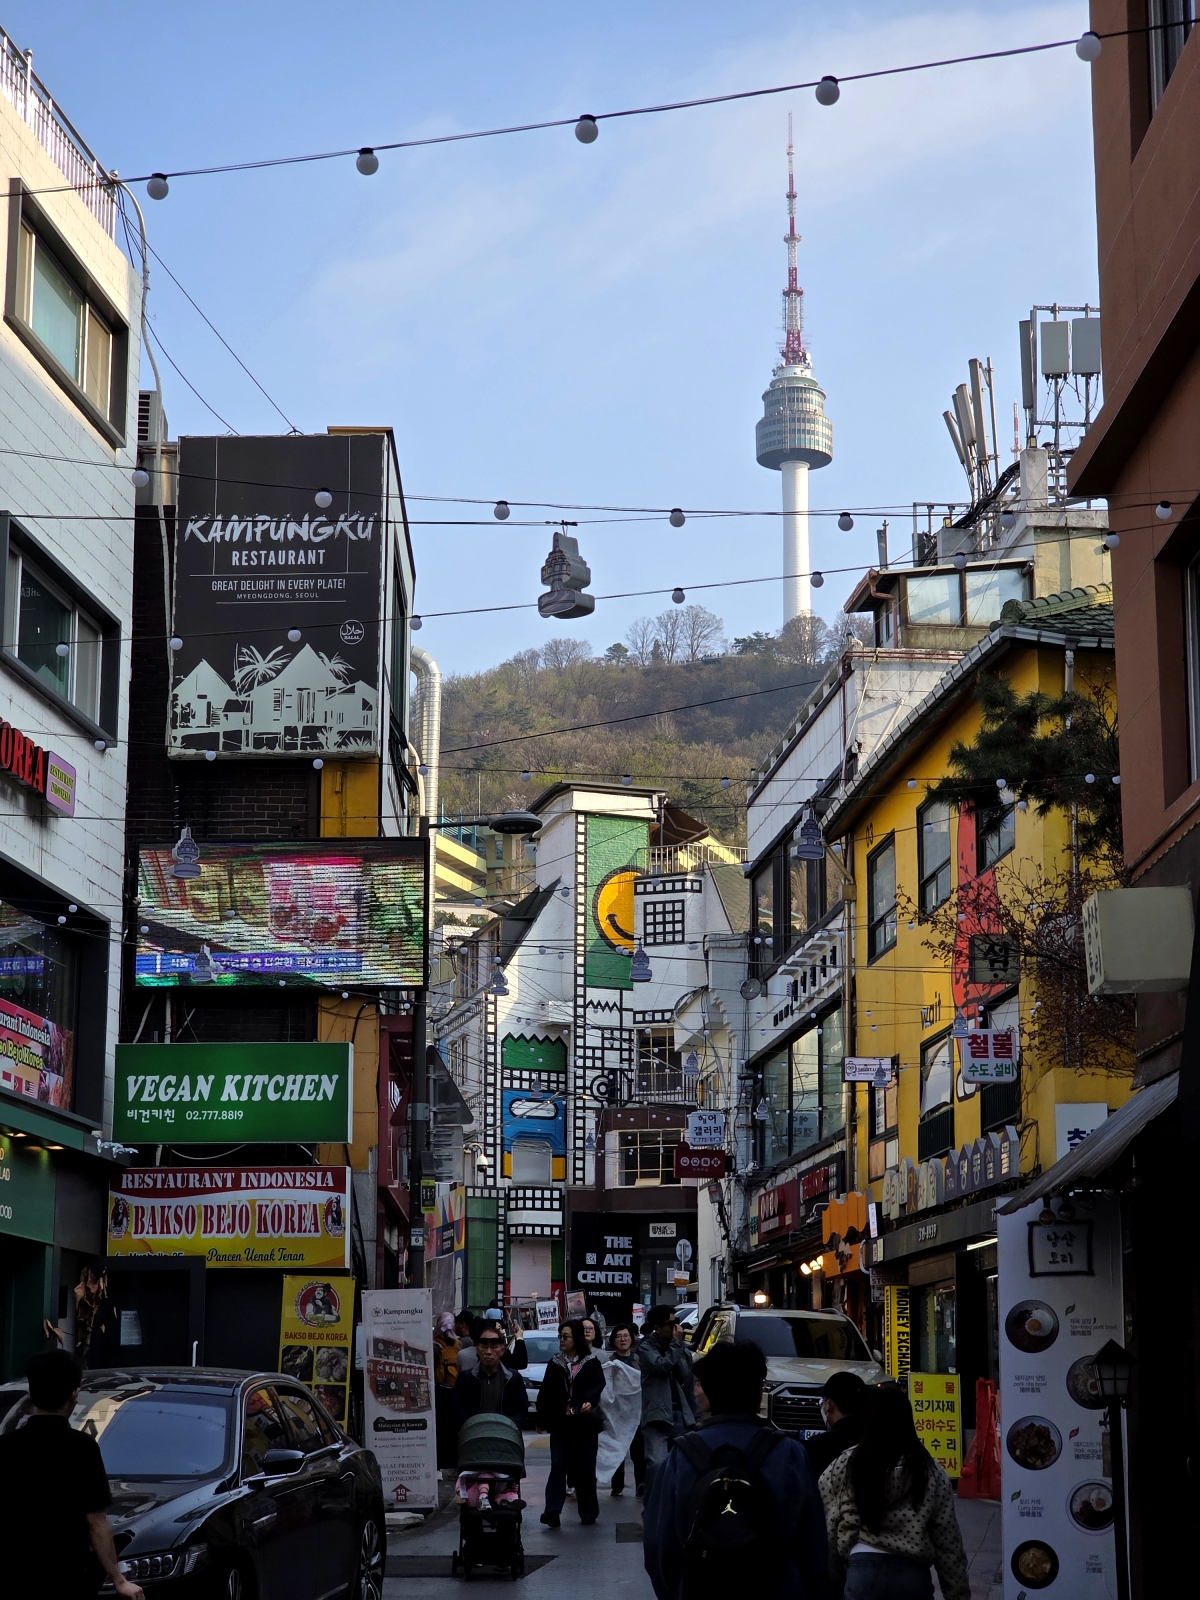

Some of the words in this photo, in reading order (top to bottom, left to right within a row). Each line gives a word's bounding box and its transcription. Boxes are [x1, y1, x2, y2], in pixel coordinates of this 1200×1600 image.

[184, 512, 378, 543] KAMPUNGKU
[231, 550, 326, 566] RESTAURANT
[211, 580, 238, 591] GREAT
[240, 580, 275, 591] DELIGHT
[277, 580, 286, 590] IN
[288, 579, 315, 590] EVERY
[317, 578, 346, 589] PLATE!
[0, 717, 44, 793] OREA
[18, 1016, 50, 1046] Indonesia
[968, 1033, 1012, 1058] 철물
[7, 1040, 23, 1065] Bejo
[23, 1047, 44, 1070] Korea
[968, 1063, 1014, 1077] 수도.설비
[126, 1075, 215, 1102] VEGAN
[220, 1074, 339, 1101] KITCHEN
[127, 1109, 175, 1123] 비건키친
[186, 1110, 244, 1121] 02.777.8819
[693, 1126, 722, 1136] 갤러리
[121, 1173, 235, 1189] RESTAURANT
[240, 1171, 334, 1187] INDONESIA
[132, 1204, 197, 1235] BAKSO
[202, 1204, 251, 1234] BEJO
[256, 1203, 321, 1234] KOREA
[414, 1236, 420, 1244] 6
[604, 1236, 633, 1249] THE
[206, 1248, 242, 1262] Pancen
[278, 1248, 305, 1262] Tenan
[603, 1254, 633, 1267] ART
[577, 1271, 633, 1284] CENTER
[383, 1308, 423, 1316] Kampungku
[896, 1288, 910, 1328] MONEY
[284, 1331, 307, 1340] BAKSO
[308, 1332, 325, 1340] BEJO
[325, 1333, 348, 1341] KOREA
[914, 1381, 924, 1394] 철
[945, 1382, 955, 1394] 물
[915, 1418, 957, 1432] 상하수도
